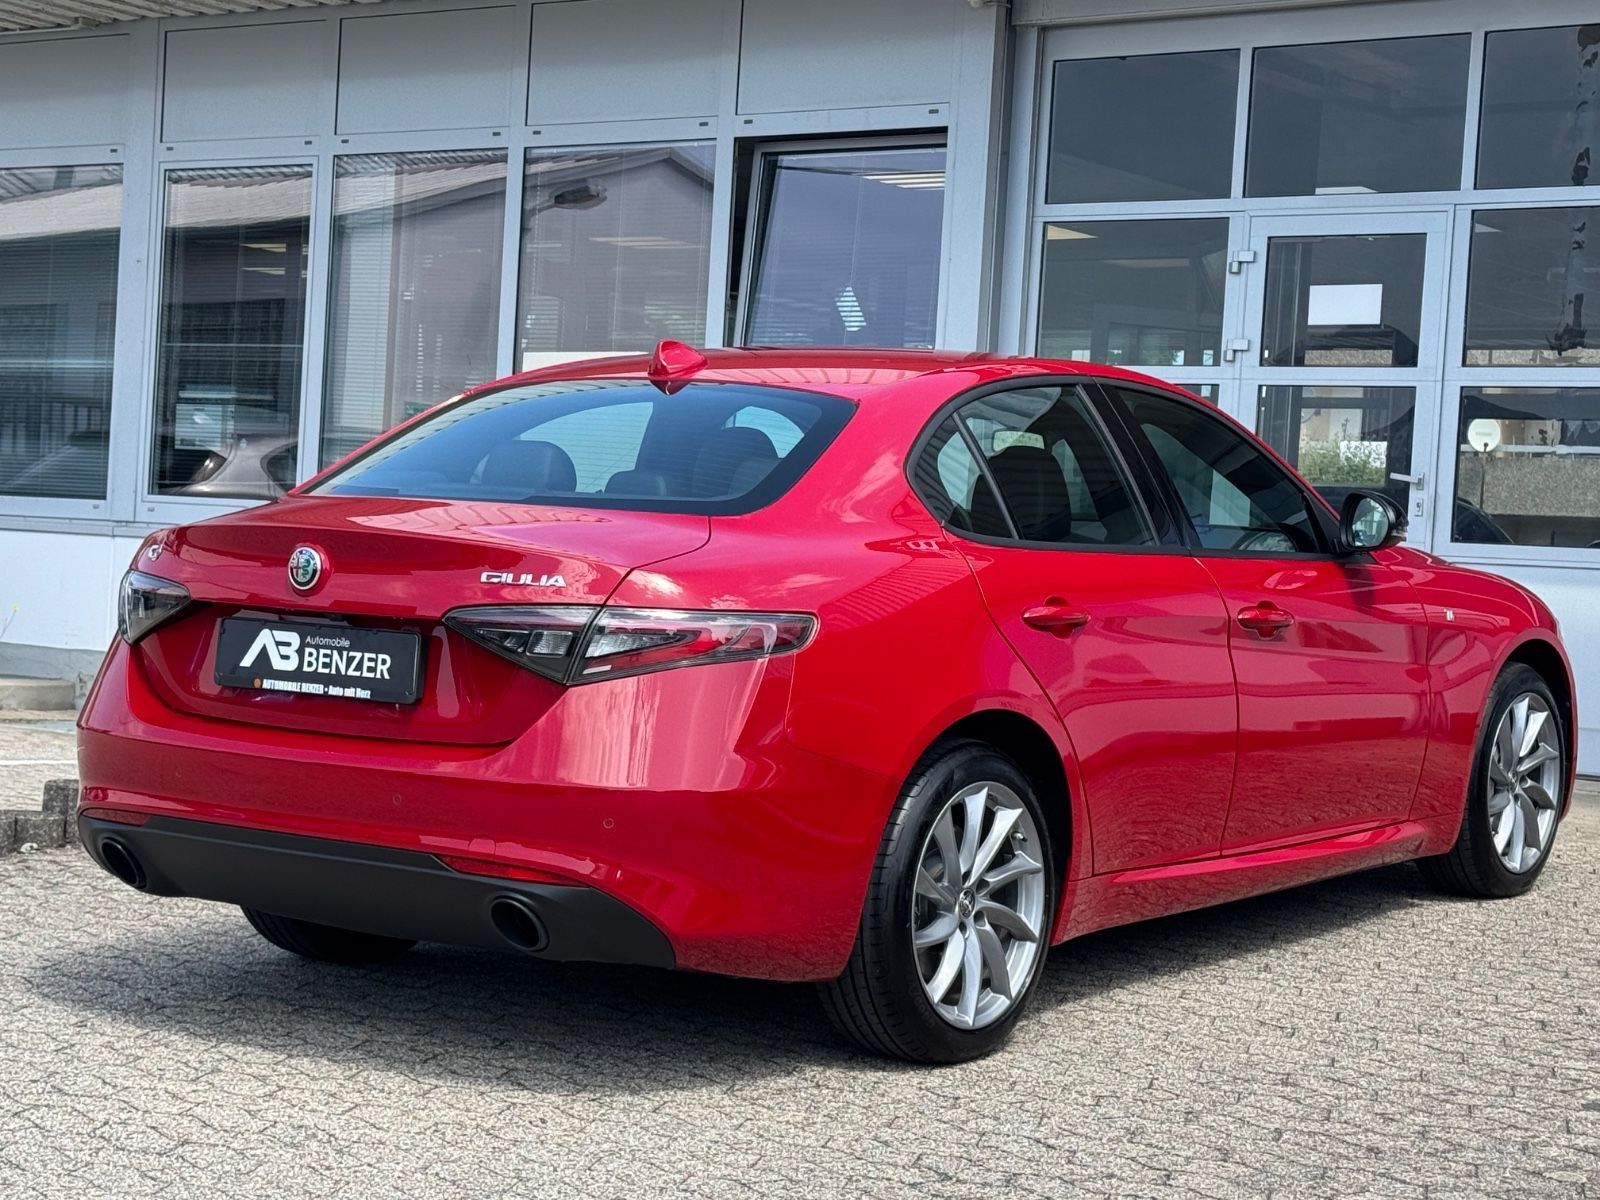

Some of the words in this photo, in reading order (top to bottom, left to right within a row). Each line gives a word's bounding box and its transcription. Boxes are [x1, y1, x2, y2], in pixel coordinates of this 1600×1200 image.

[480, 571, 567, 588] GIULIA
[305, 635, 351, 648] Automobile
[302, 647, 392, 680] BENZER
[262, 679, 301, 692] AUTOMOBILE
[301, 682, 324, 694] BENZER
[328, 685, 344, 696] Auto
[344, 687, 356, 697] mit
[356, 687, 371, 699] Herz
